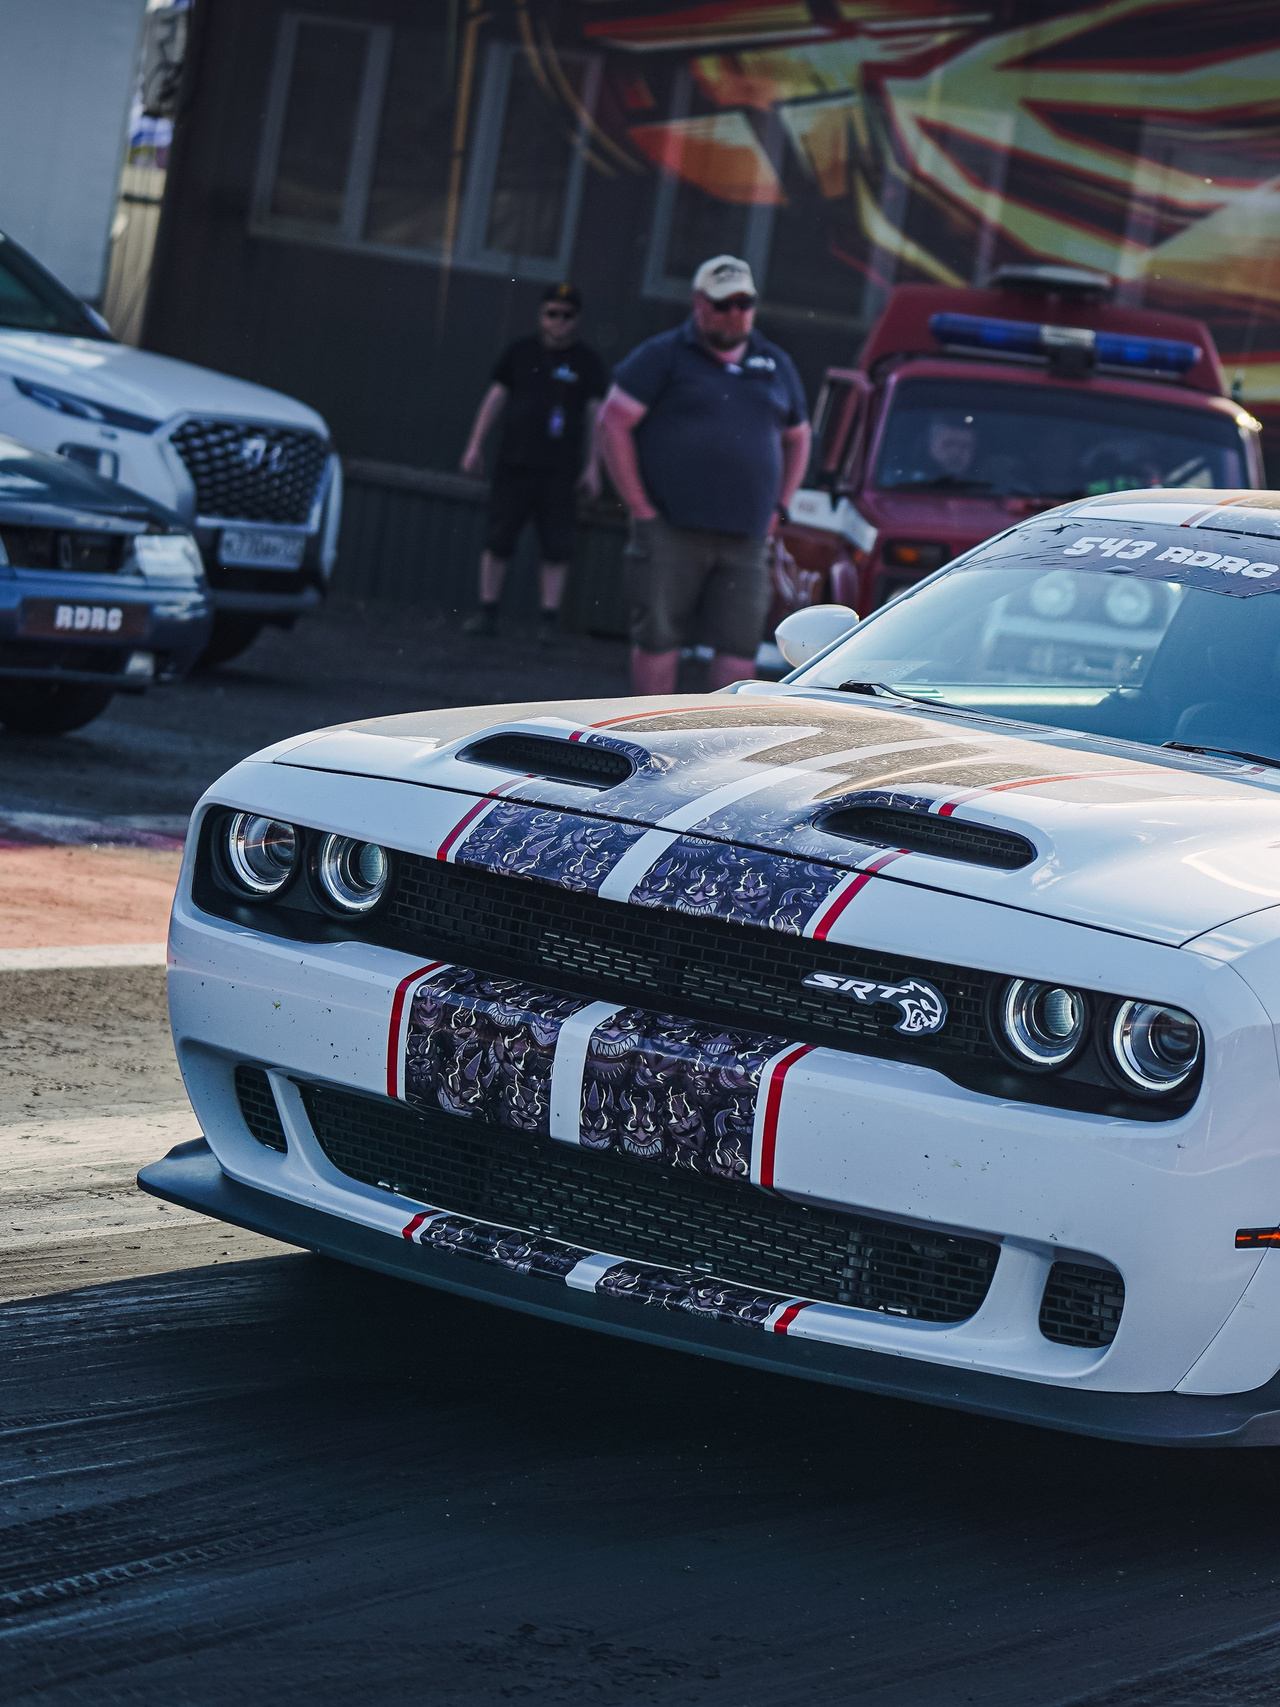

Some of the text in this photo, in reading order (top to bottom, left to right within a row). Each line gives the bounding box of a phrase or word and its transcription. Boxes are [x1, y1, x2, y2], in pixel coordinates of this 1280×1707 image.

[1063, 537, 1280, 579] 543 RDRC
[803, 973, 910, 1001] SRT
